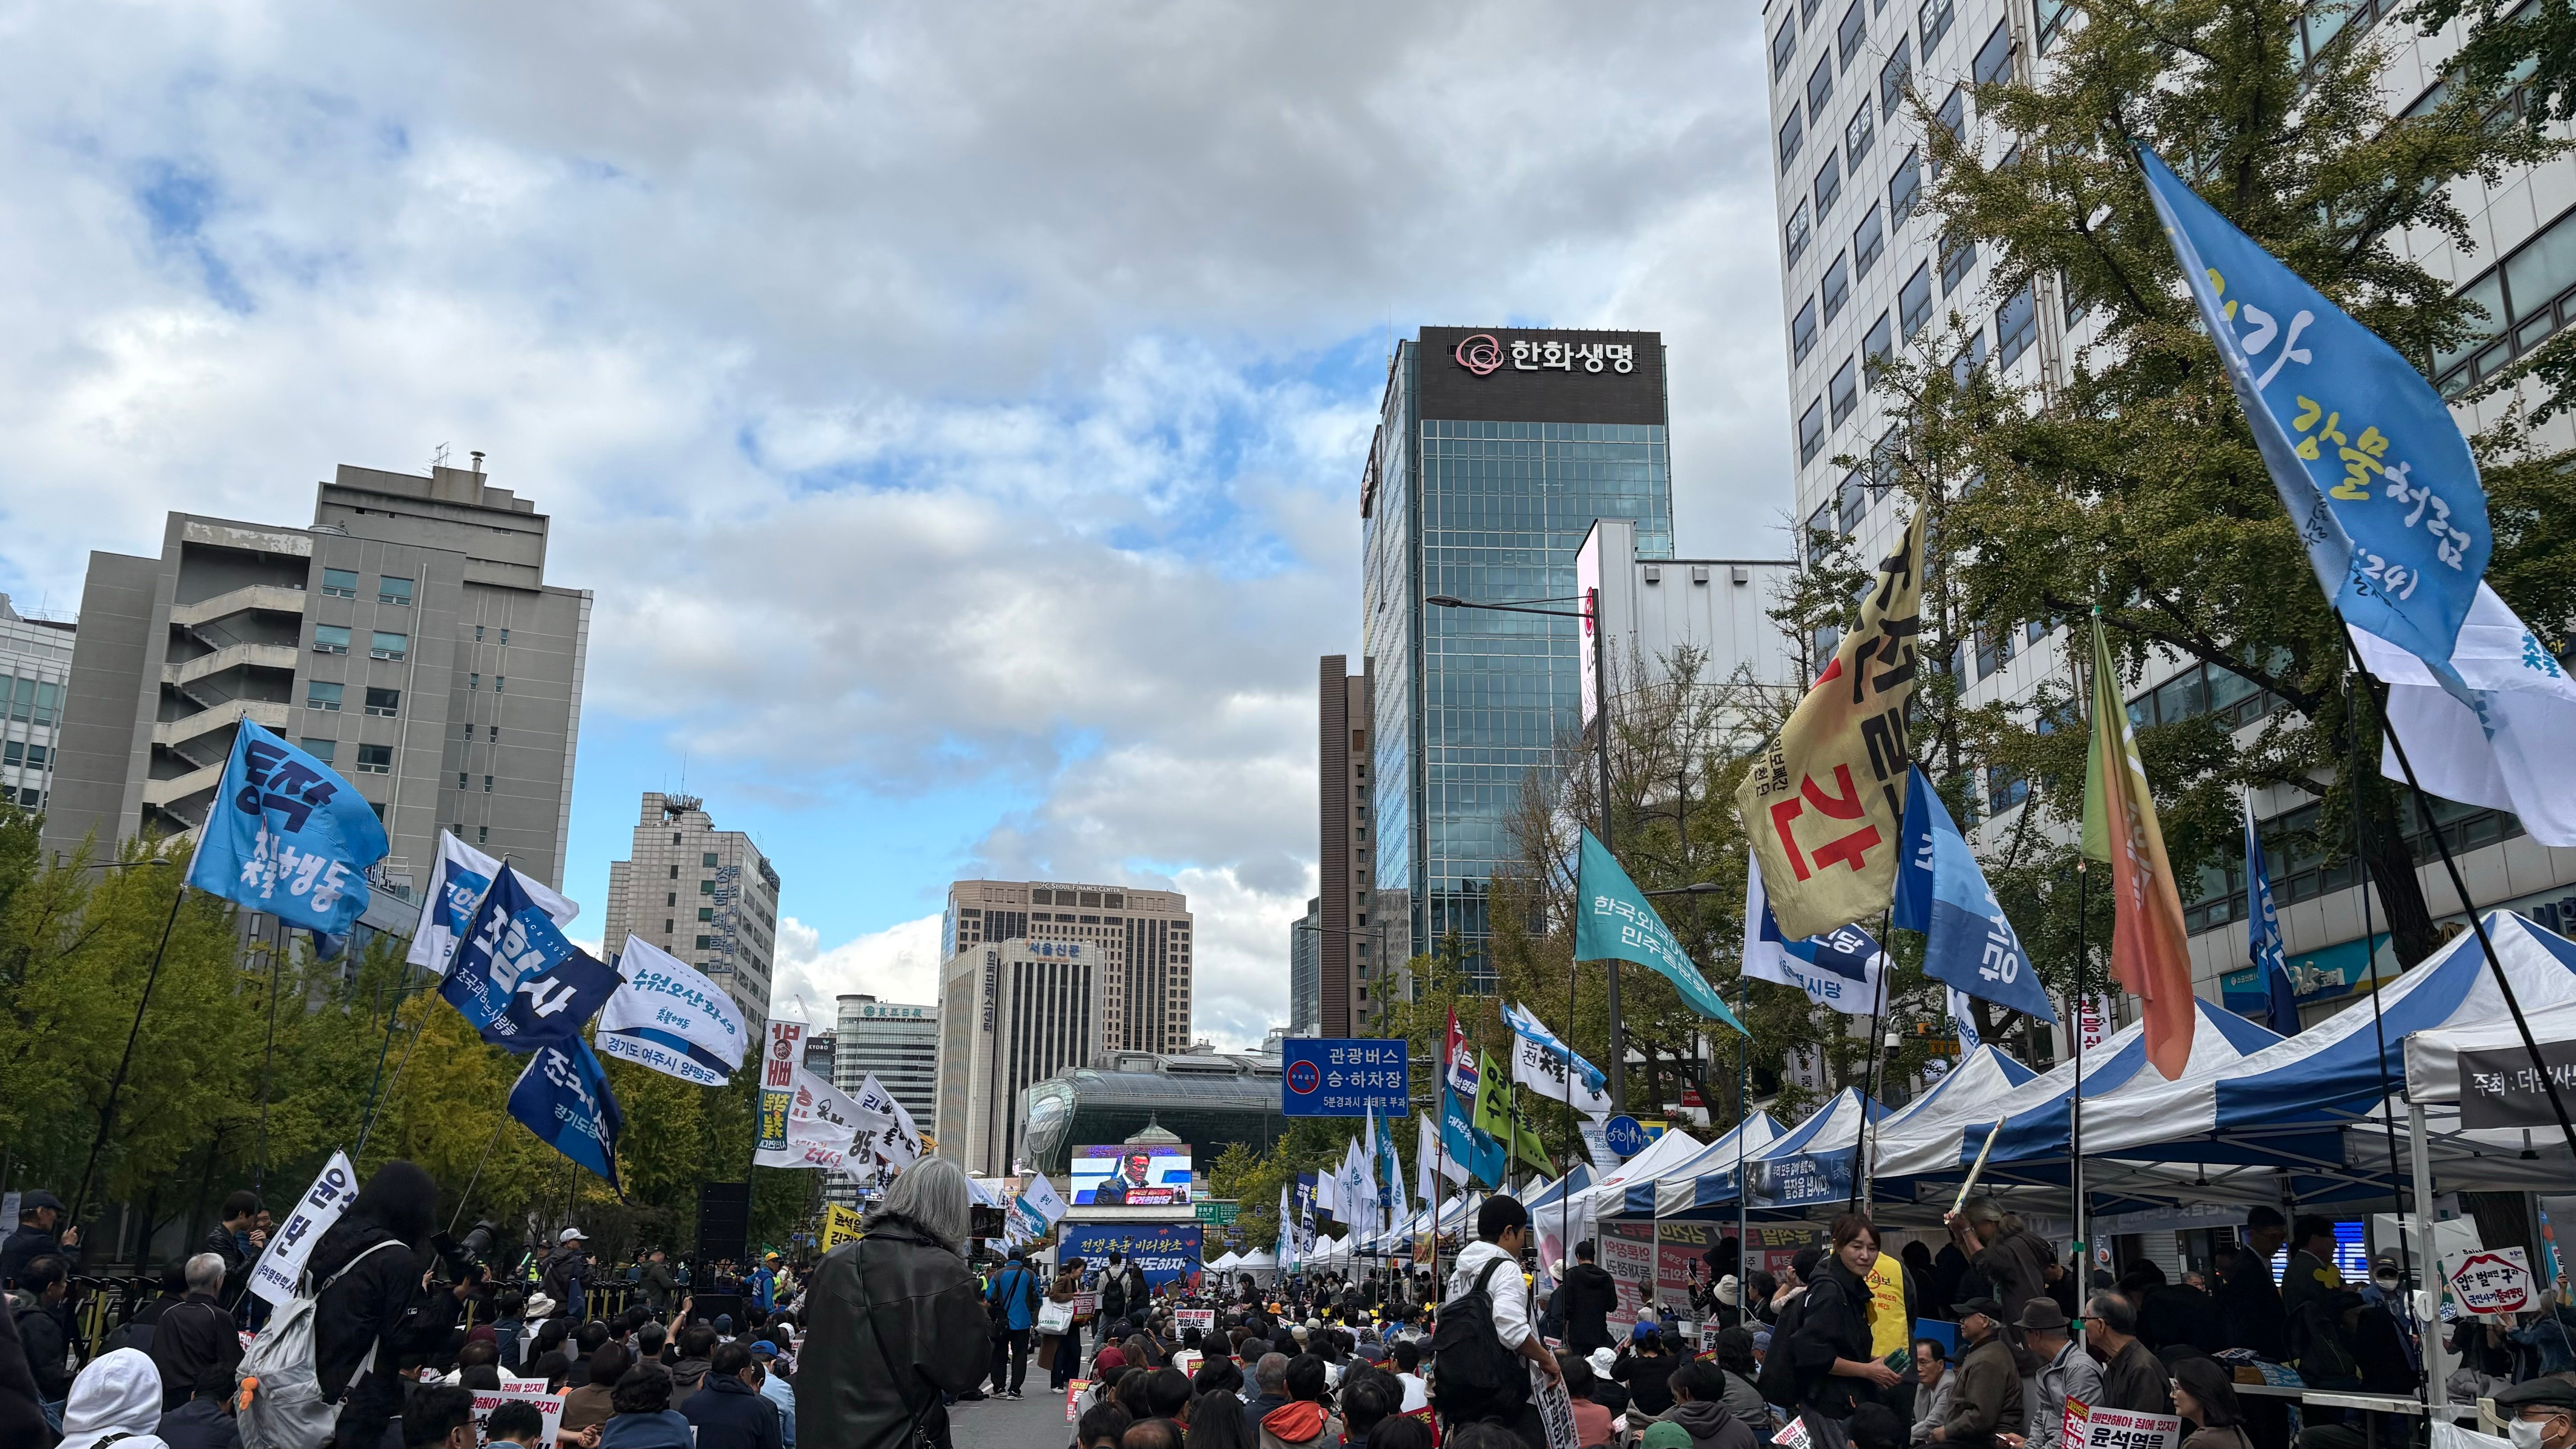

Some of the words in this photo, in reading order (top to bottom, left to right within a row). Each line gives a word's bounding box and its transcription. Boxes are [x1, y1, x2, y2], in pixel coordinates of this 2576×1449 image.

[1510, 339, 1633, 373] 한화생명
[2292, 395, 2471, 571] 강물처럼
[1770, 763, 1881, 882] 간
[1029, 942, 1080, 957] 서울신문
[632, 968, 736, 1035] 수원오산화성
[984, 951, 996, 1034] 한국프레스센터
[656, 1007, 691, 1030] 촛불행동
[608, 1037, 639, 1057] 경기도
[642, 1048, 677, 1071] 여주시
[680, 1062, 716, 1084] 양평군
[1329, 1047, 1399, 1065] 관광버스
[1326, 1071, 1402, 1089] 승·하차장
[2472, 1071, 2505, 1096] 주최
[1323, 1096, 1360, 1109] 5분경과시
[1389, 1096, 1406, 1109] 부과
[1135, 1239, 1183, 1254] 비리왕초
[2456, 1274, 2474, 1292] 입만
[2501, 1268, 2519, 1283] 구라
[1176, 1318, 1206, 1327] 계엄시도
[502, 1383, 523, 1393] 집에
[523, 1383, 545, 1393] 있지!
[2067, 1399, 2088, 1419] 대한민국
[2090, 1412, 2133, 1428] 웬만해야
[2134, 1417, 2156, 1431] 집에
[2156, 1420, 2178, 1432] 있지!
[1776, 1425, 1798, 1445] 100만
[2090, 1427, 2164, 1449] 윤석열을
